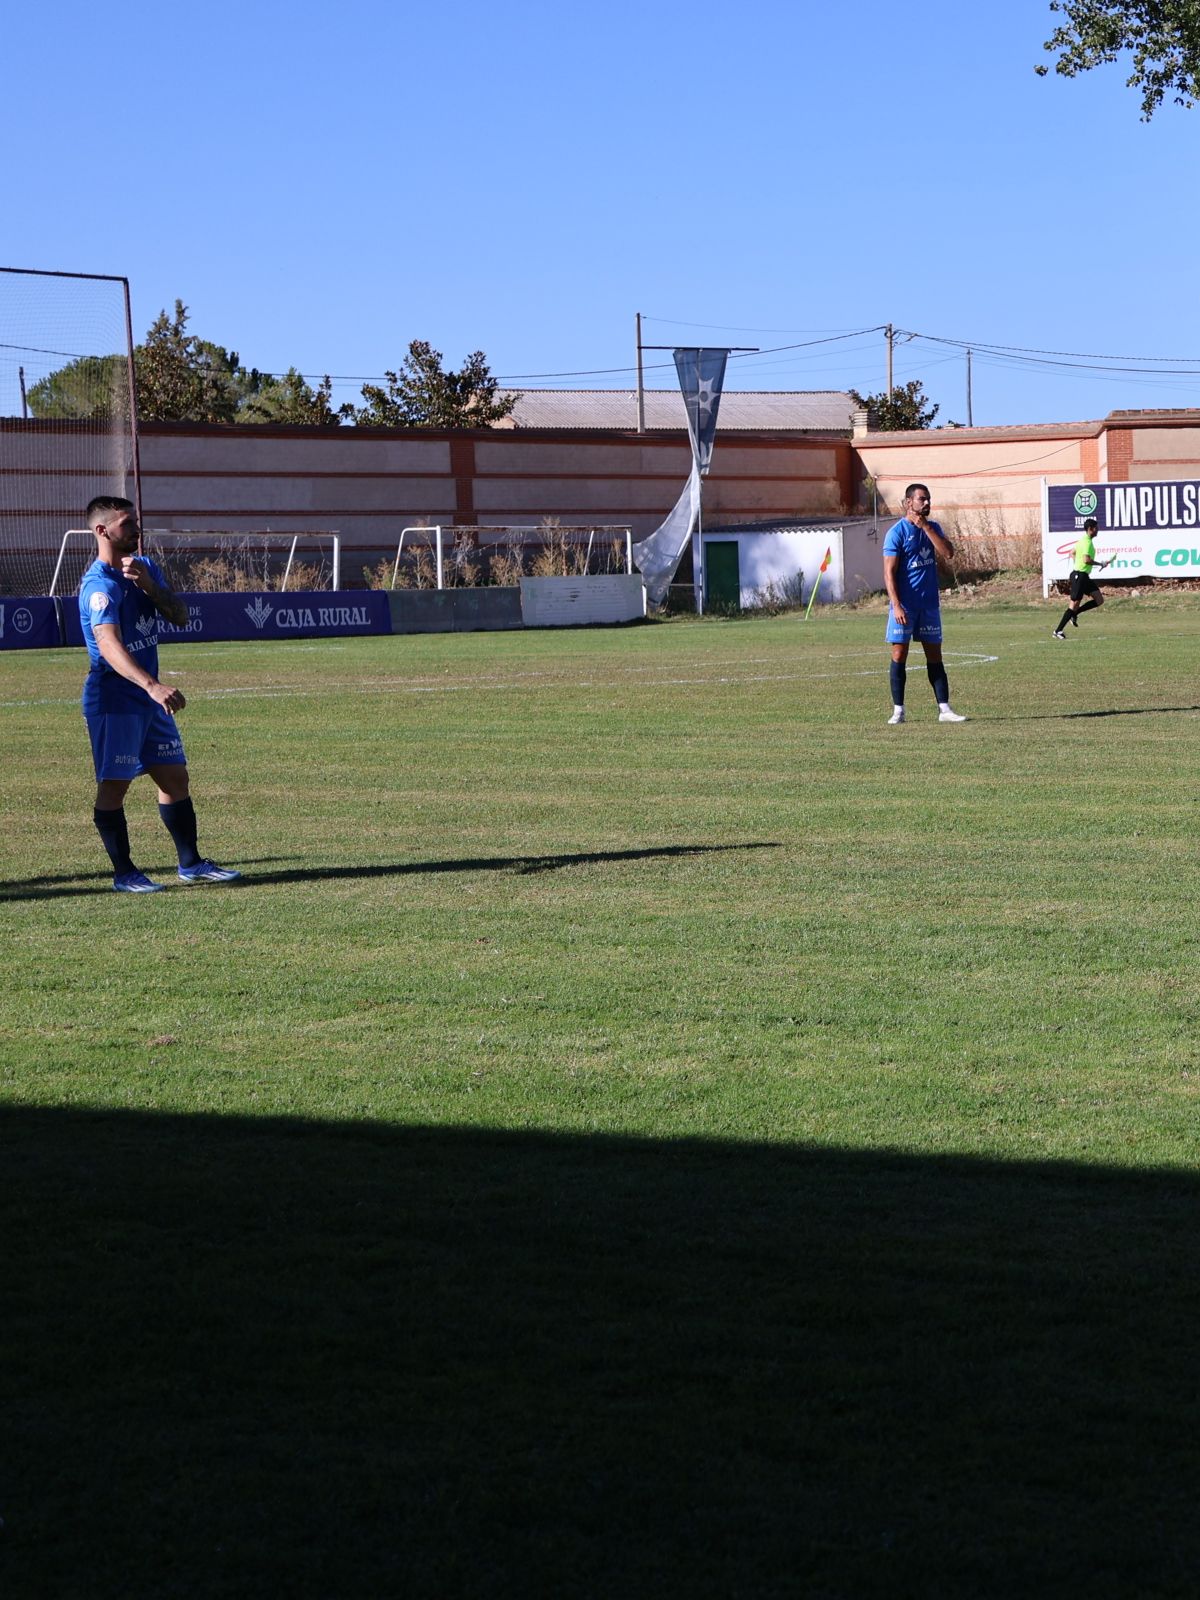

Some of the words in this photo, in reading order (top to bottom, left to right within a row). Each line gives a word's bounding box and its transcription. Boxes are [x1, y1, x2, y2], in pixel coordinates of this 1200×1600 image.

[189, 606, 202, 616] DE
[276, 609, 316, 628] CAJA
[318, 607, 371, 626] RURAL
